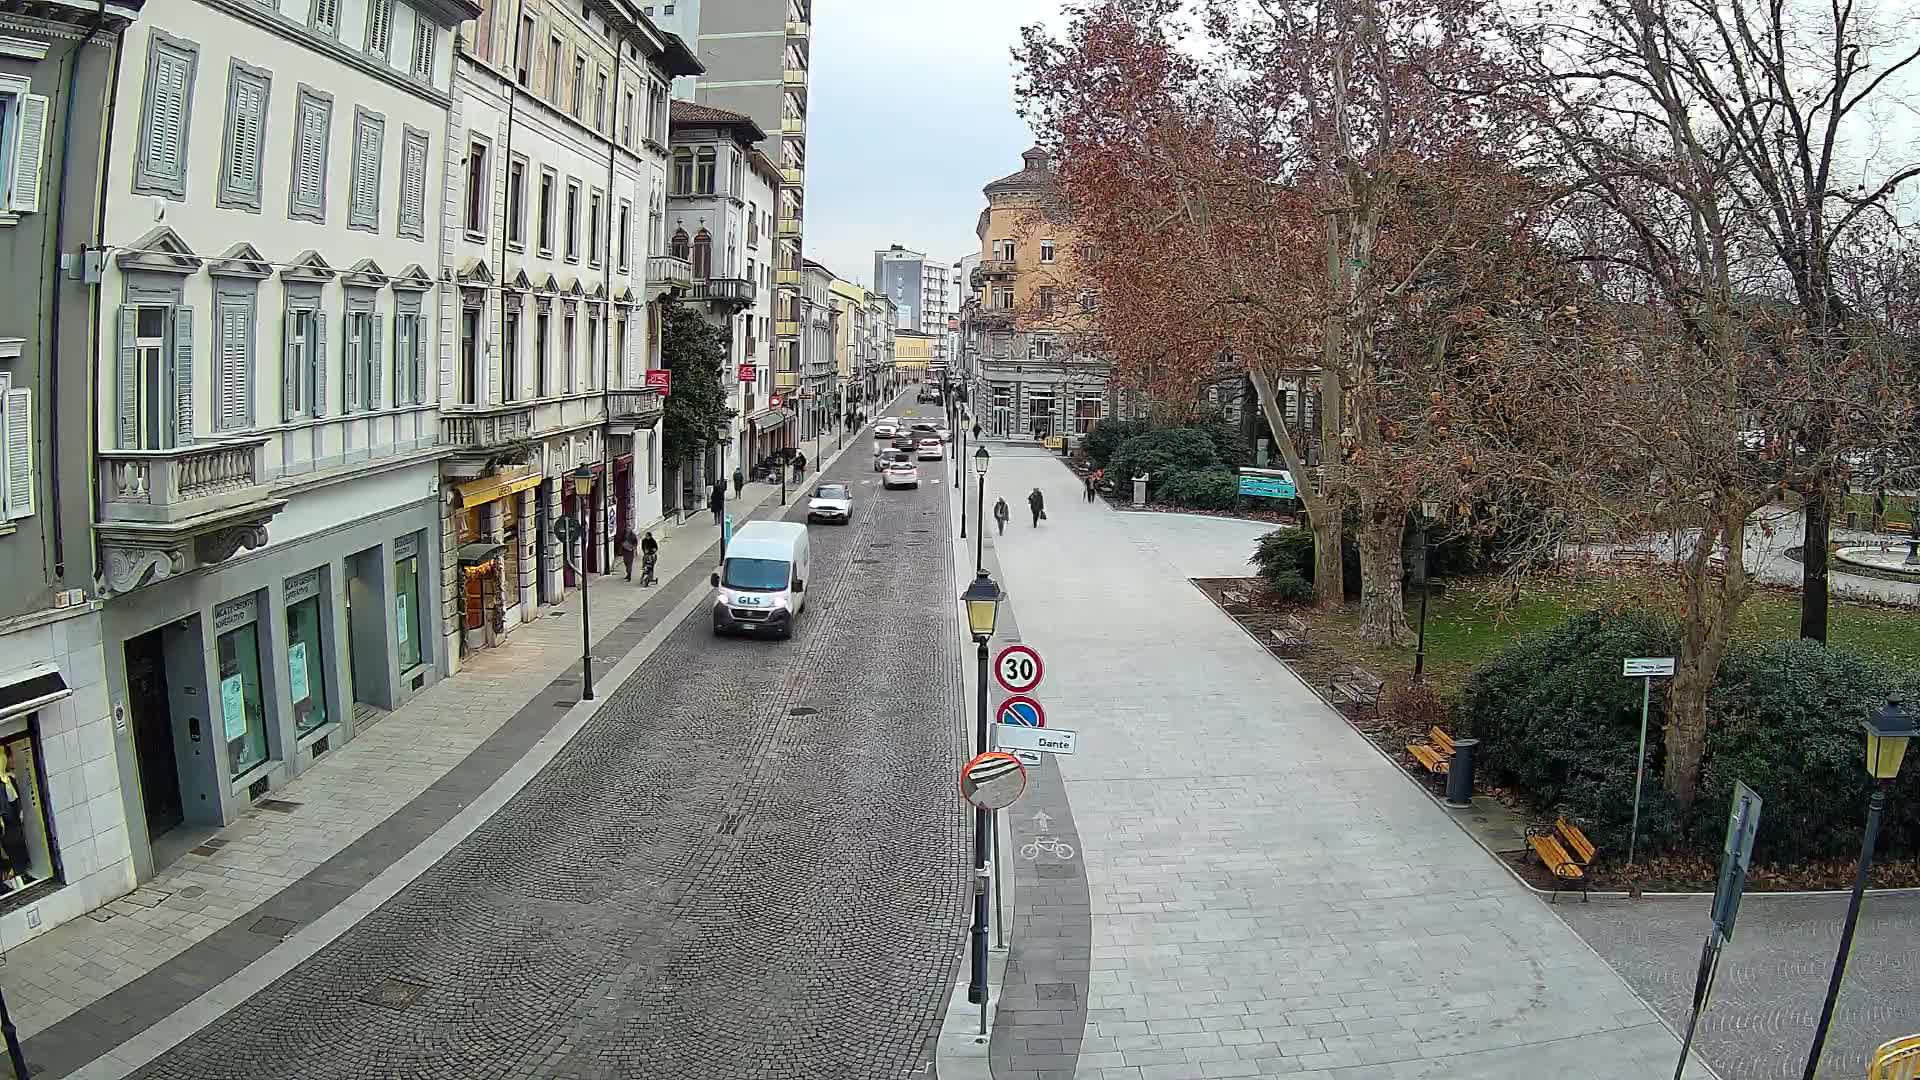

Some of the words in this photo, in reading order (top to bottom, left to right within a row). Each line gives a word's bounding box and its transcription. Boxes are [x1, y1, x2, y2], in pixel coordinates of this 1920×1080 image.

[738, 596, 760, 605] GLS
[1005, 658, 1033, 680] 30
[1038, 738, 1070, 749] Dante
